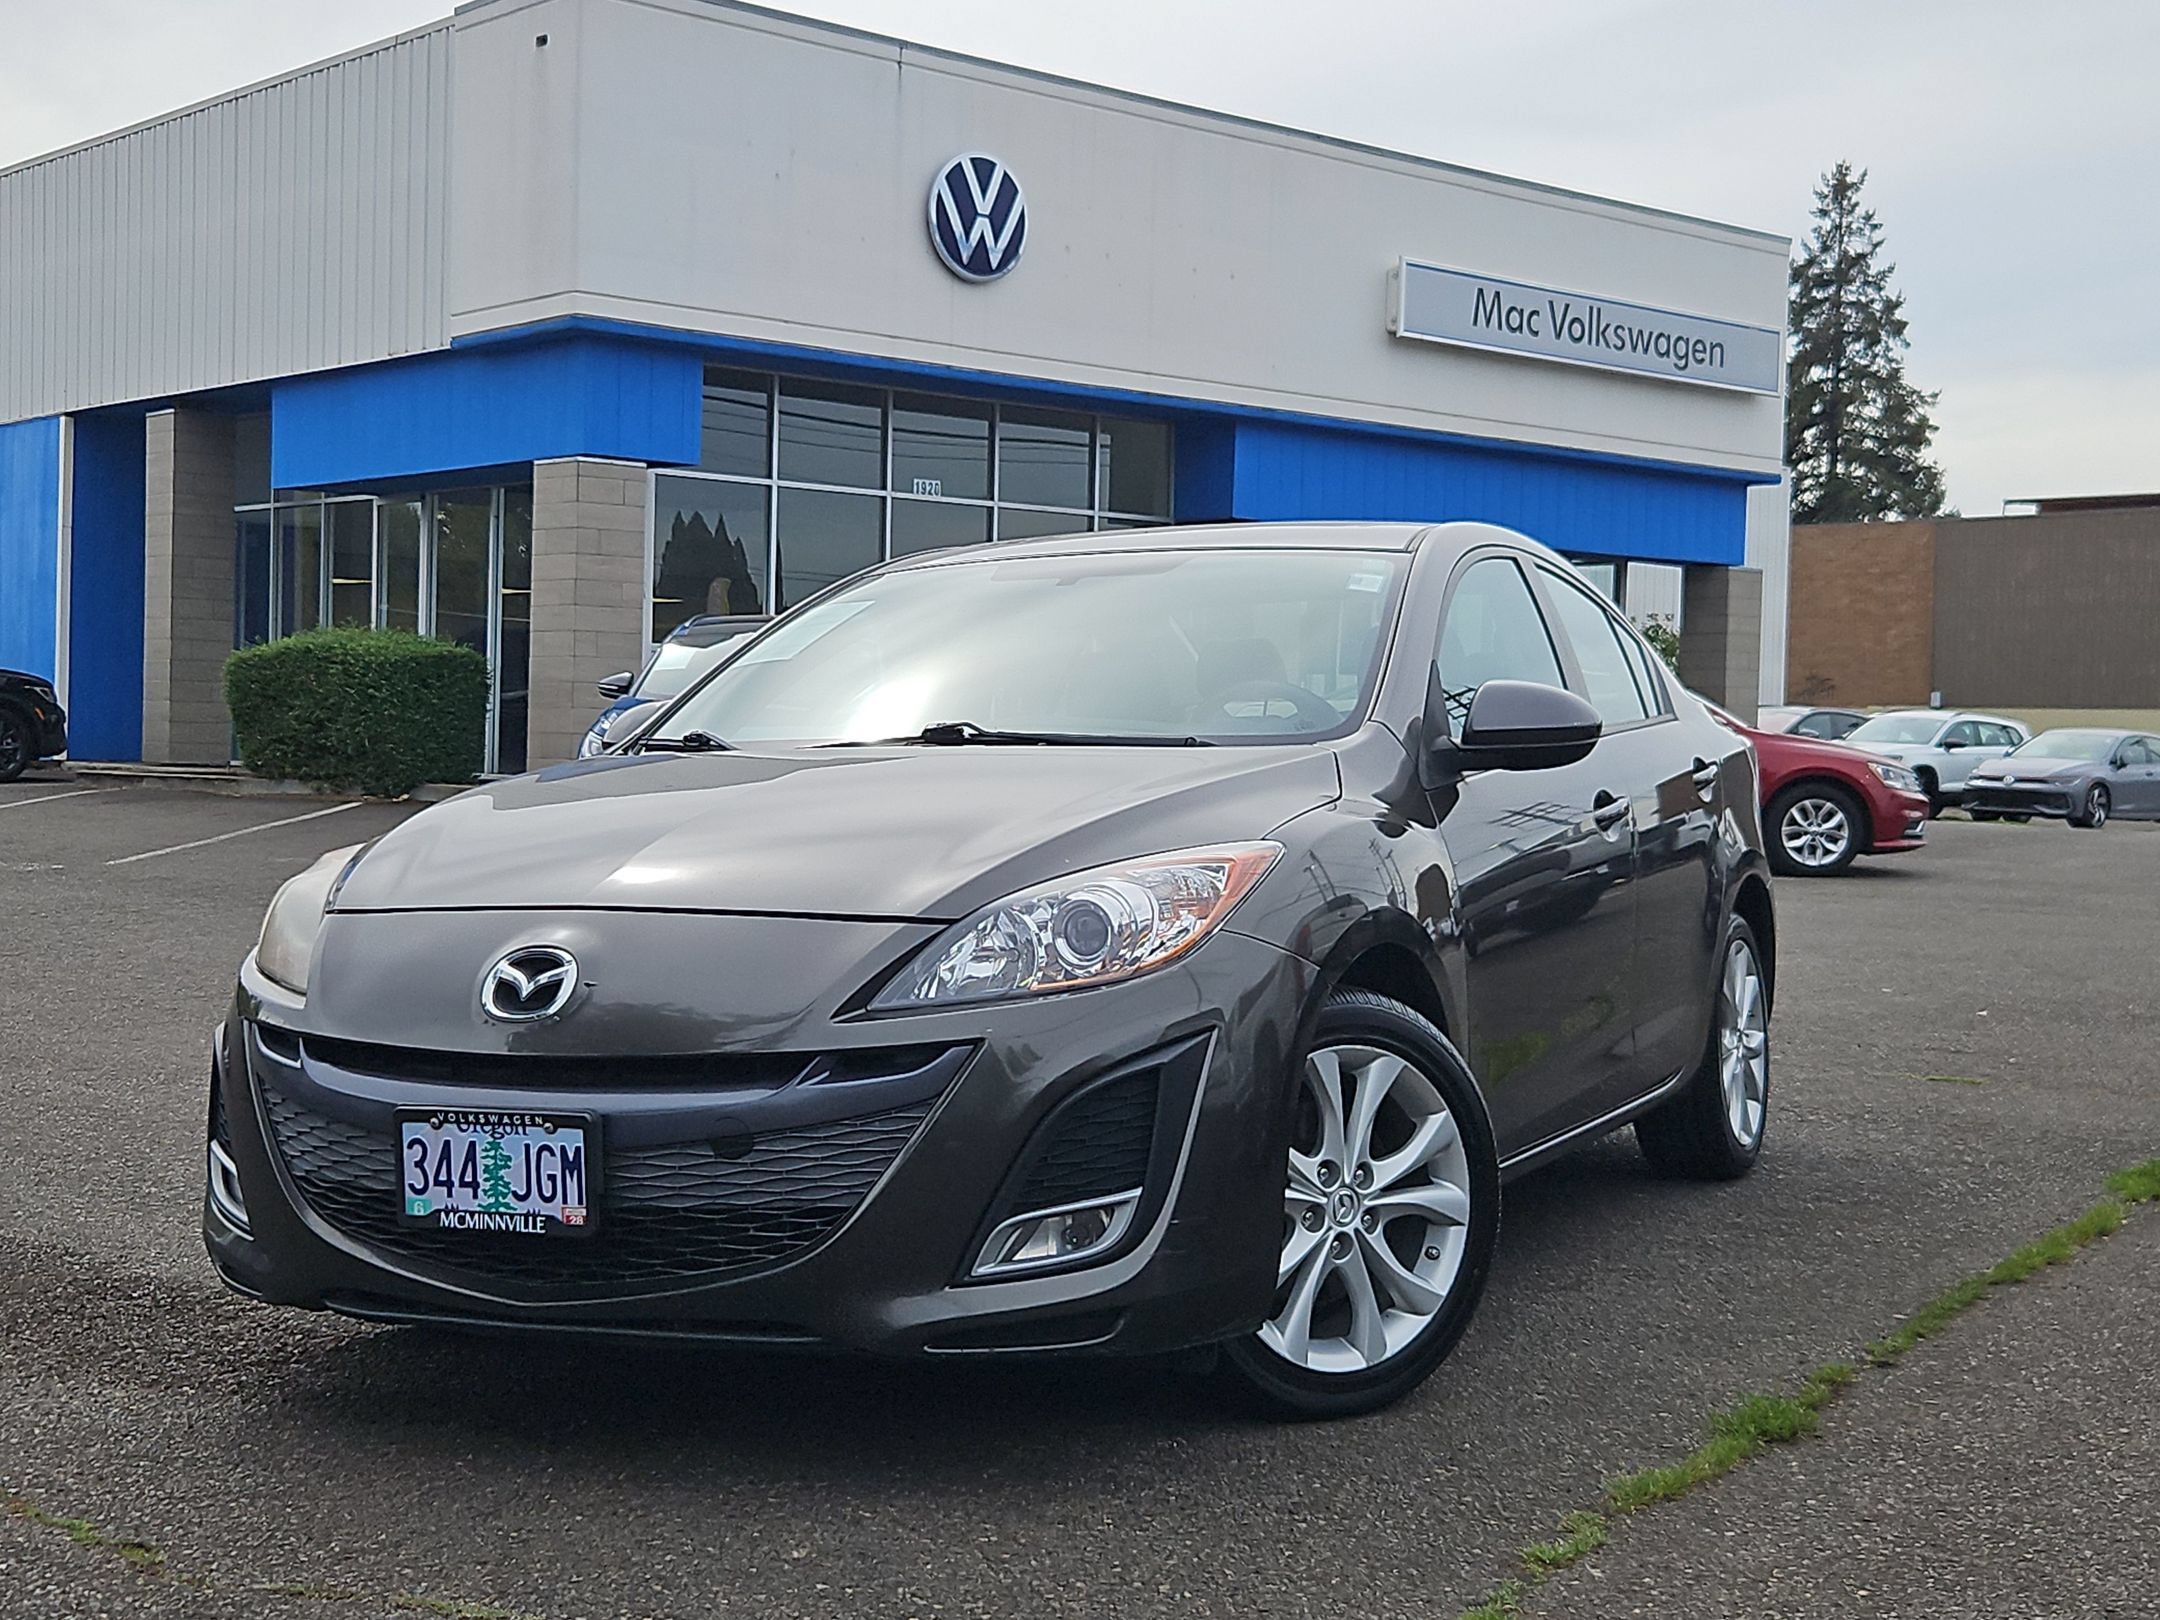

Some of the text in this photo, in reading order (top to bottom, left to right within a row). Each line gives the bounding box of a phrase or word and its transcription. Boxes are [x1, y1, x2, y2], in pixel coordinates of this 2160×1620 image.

[1471, 287, 1725, 372] Mac Volkswagen
[916, 481, 940, 496] 1920
[437, 1112, 544, 1126] VOLKSWAGEN
[407, 1137, 584, 1205] 344 JGM
[440, 1211, 546, 1233] MCMINNVILLE
